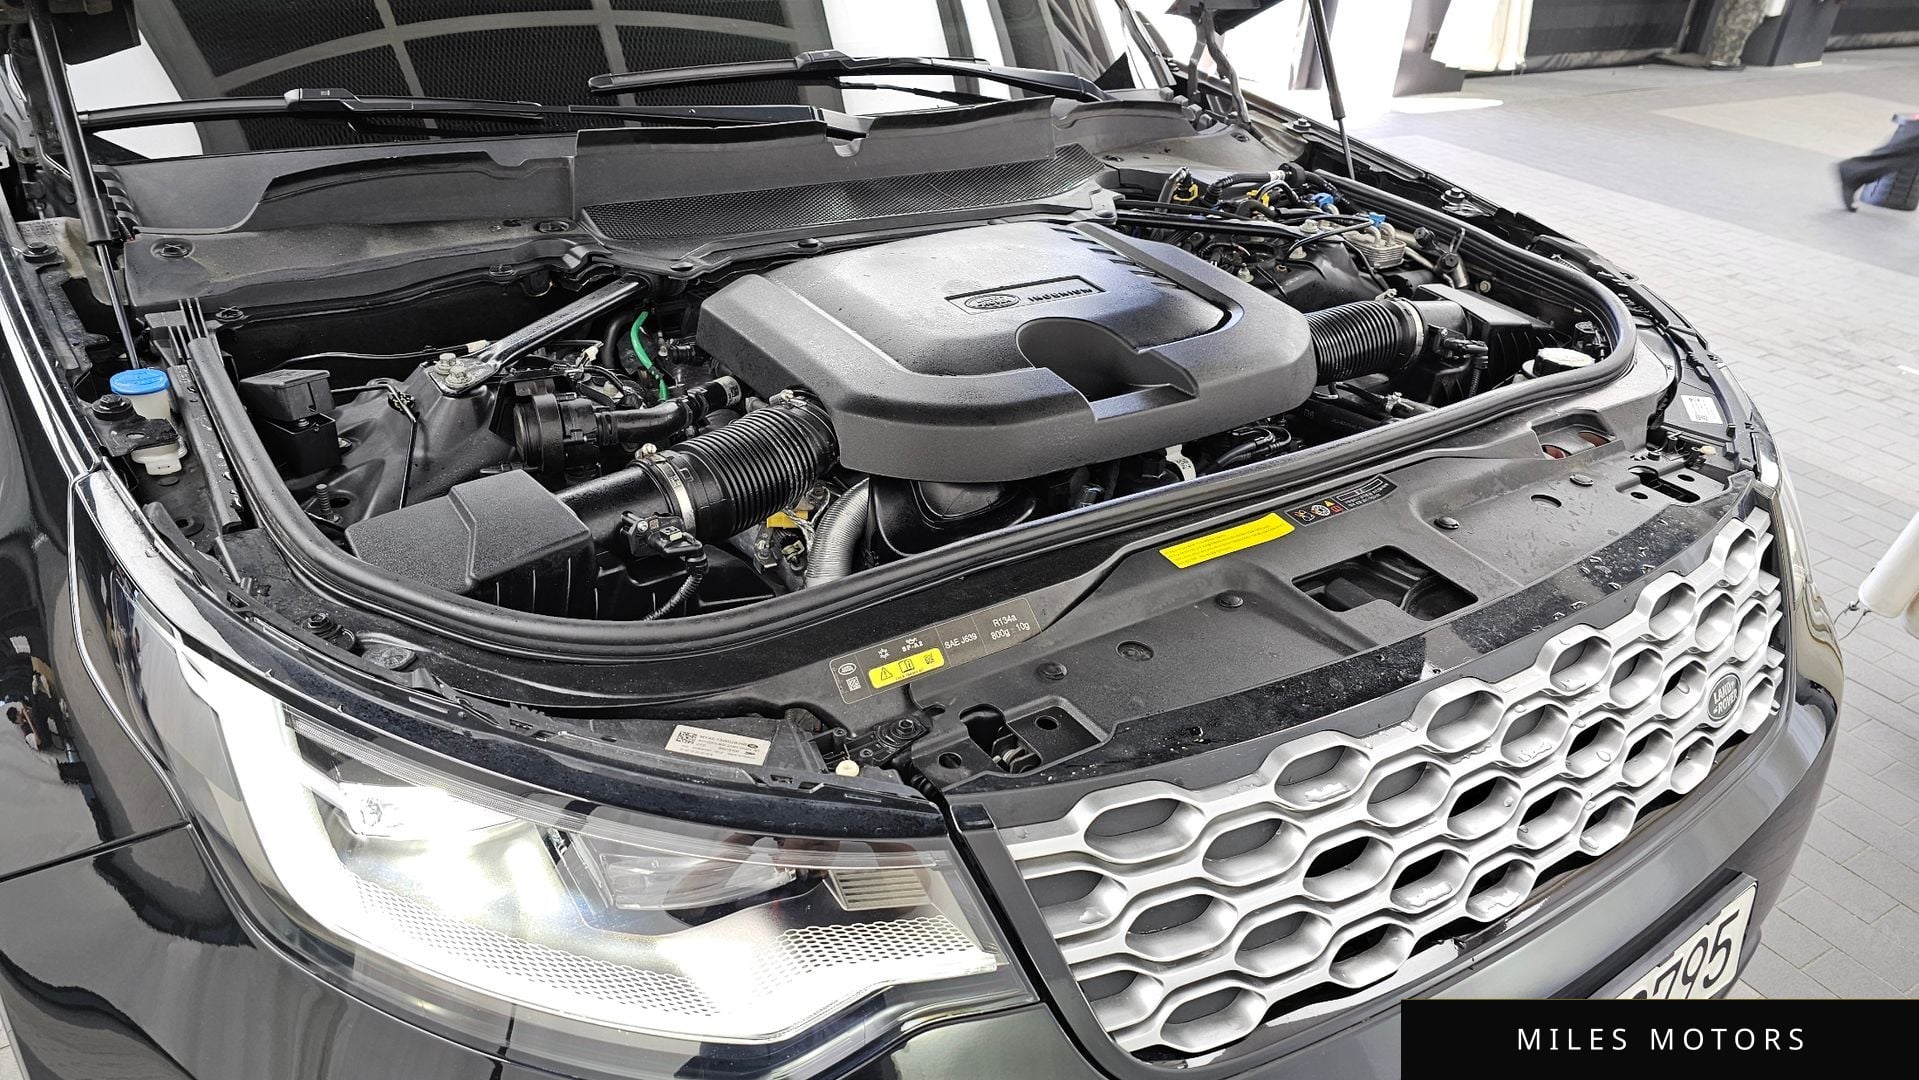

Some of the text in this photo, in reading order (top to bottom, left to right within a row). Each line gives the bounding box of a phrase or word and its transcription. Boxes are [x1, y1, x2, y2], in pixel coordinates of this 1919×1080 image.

[990, 622, 1031, 640] 800g 10g
[992, 614, 1018, 628] R134a
[944, 632, 978, 649] SAE J639
[1713, 681, 1732, 705] LAND
[1717, 688, 1738, 715] ROVER
[1632, 908, 1741, 999] 795
